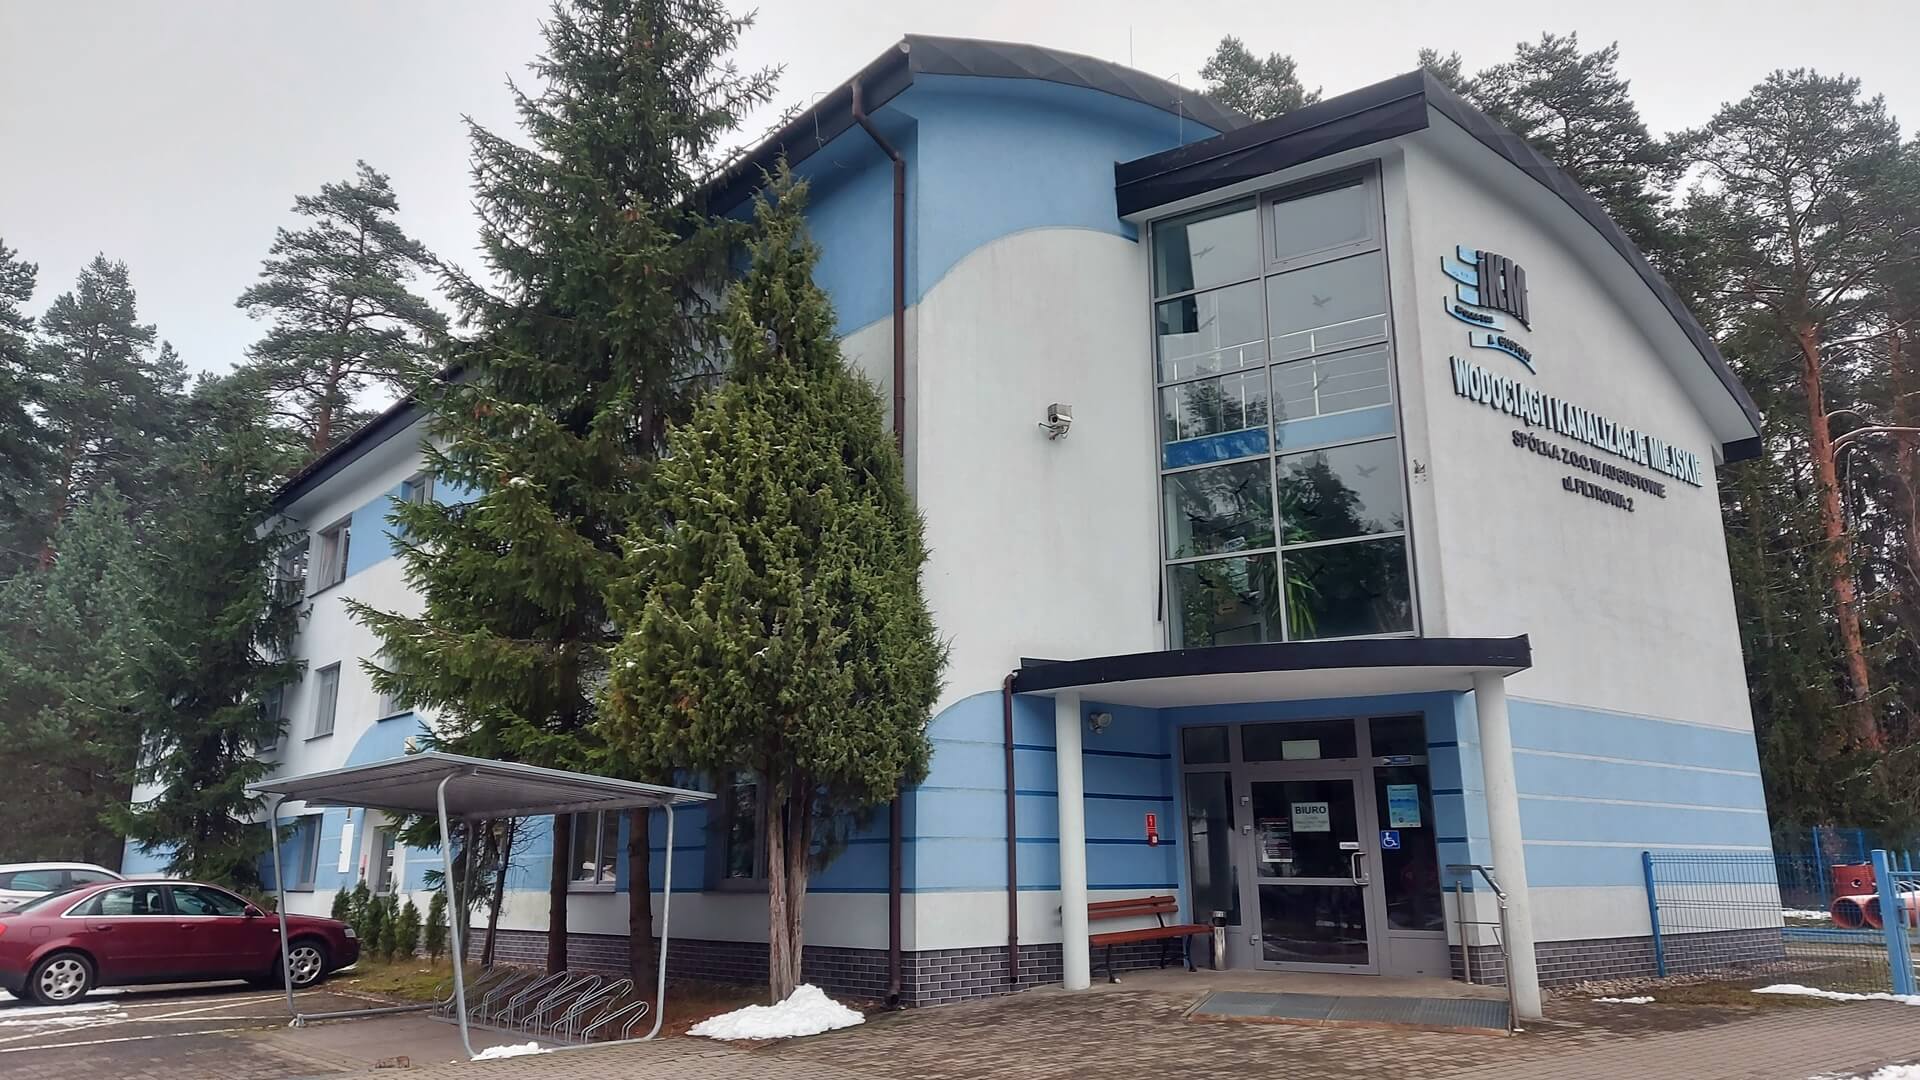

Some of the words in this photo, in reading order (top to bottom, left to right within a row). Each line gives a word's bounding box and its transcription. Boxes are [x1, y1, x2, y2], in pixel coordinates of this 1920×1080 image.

[1449, 355, 1544, 427] WODOCIĄGI
[1543, 394, 1553, 429] I
[1551, 398, 1649, 466] KANALIZACJE
[1645, 436, 1704, 487] MIEJSKIE
[1512, 430, 1561, 461] SPÓŁKA
[1590, 458, 1602, 475] W
[1602, 463, 1666, 498] AUGUSTOWIE
[1574, 478, 1626, 510] FILTROWA
[1625, 497, 1635, 512] 2
[1295, 806, 1327, 815] BIURO
